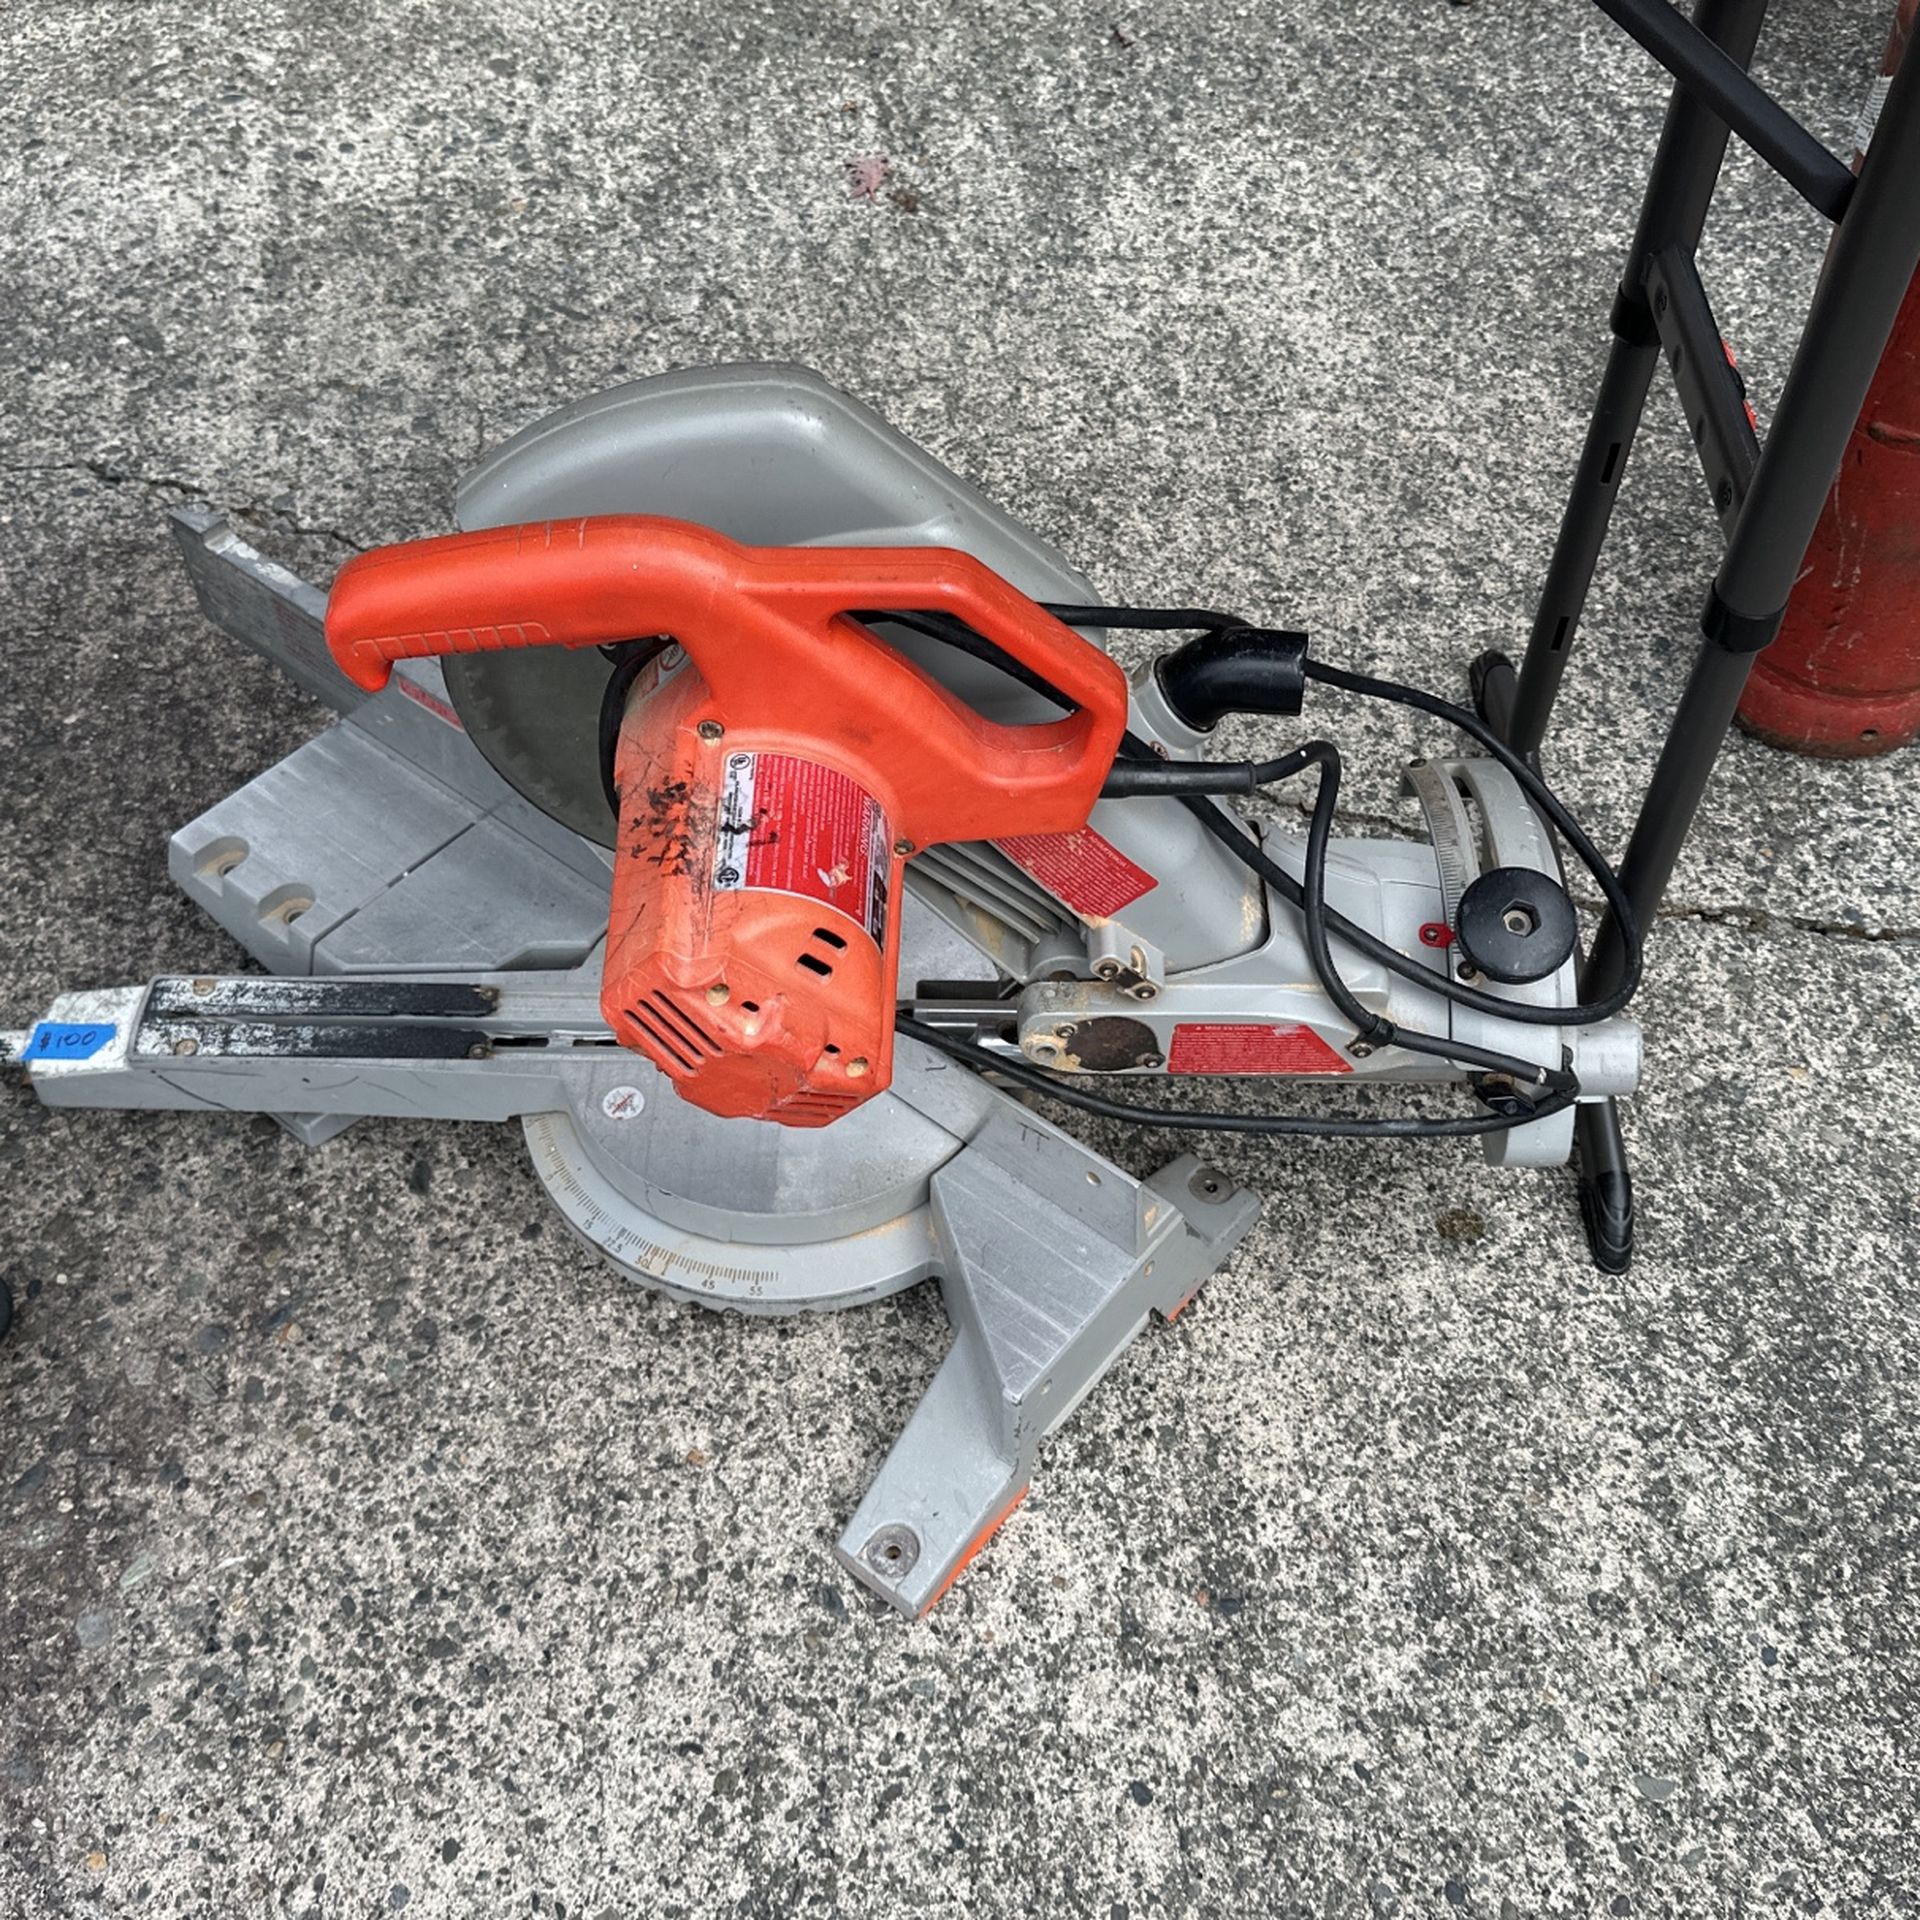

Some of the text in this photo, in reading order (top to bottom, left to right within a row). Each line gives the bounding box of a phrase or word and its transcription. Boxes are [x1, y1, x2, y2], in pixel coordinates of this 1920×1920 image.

[38, 1030, 97, 1051] $100
[701, 1279, 716, 1290] 45
[749, 1285, 763, 1297] 55
